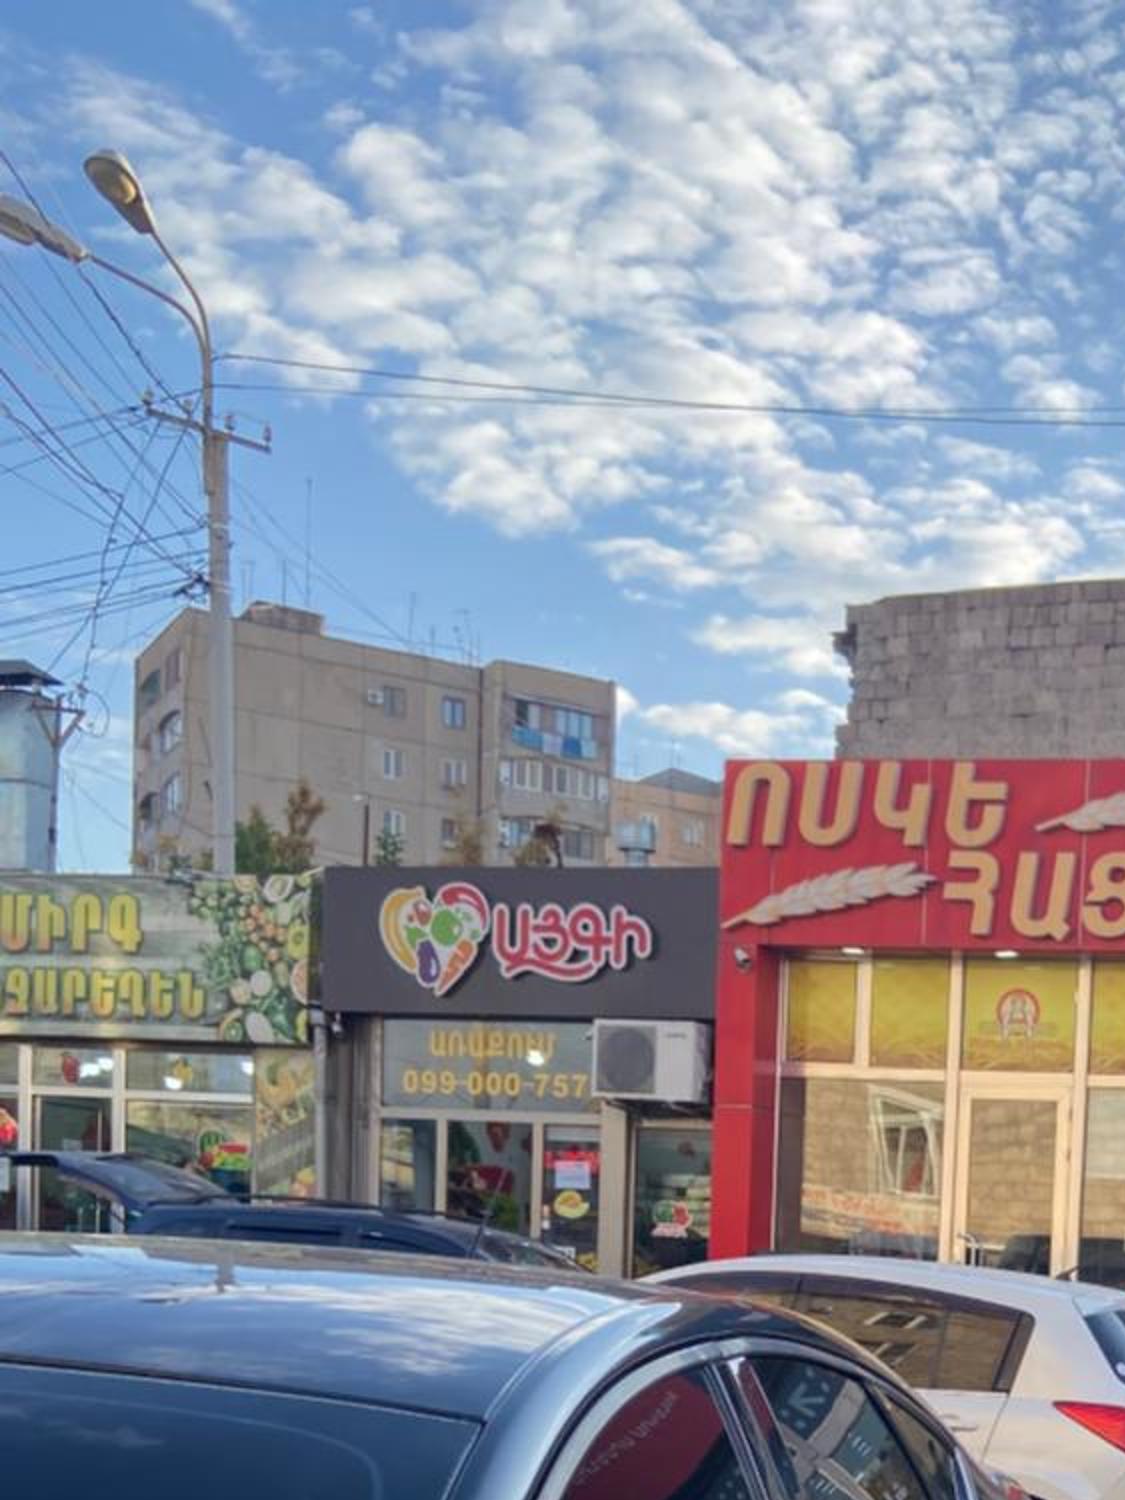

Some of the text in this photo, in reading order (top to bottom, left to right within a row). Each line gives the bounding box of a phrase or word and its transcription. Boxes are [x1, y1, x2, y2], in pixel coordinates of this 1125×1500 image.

[726, 762, 1008, 848] ՈՍԿԵ
[492, 903, 652, 983] ԱՅԳԻ
[403, 1069, 588, 1098] 099-000-757
